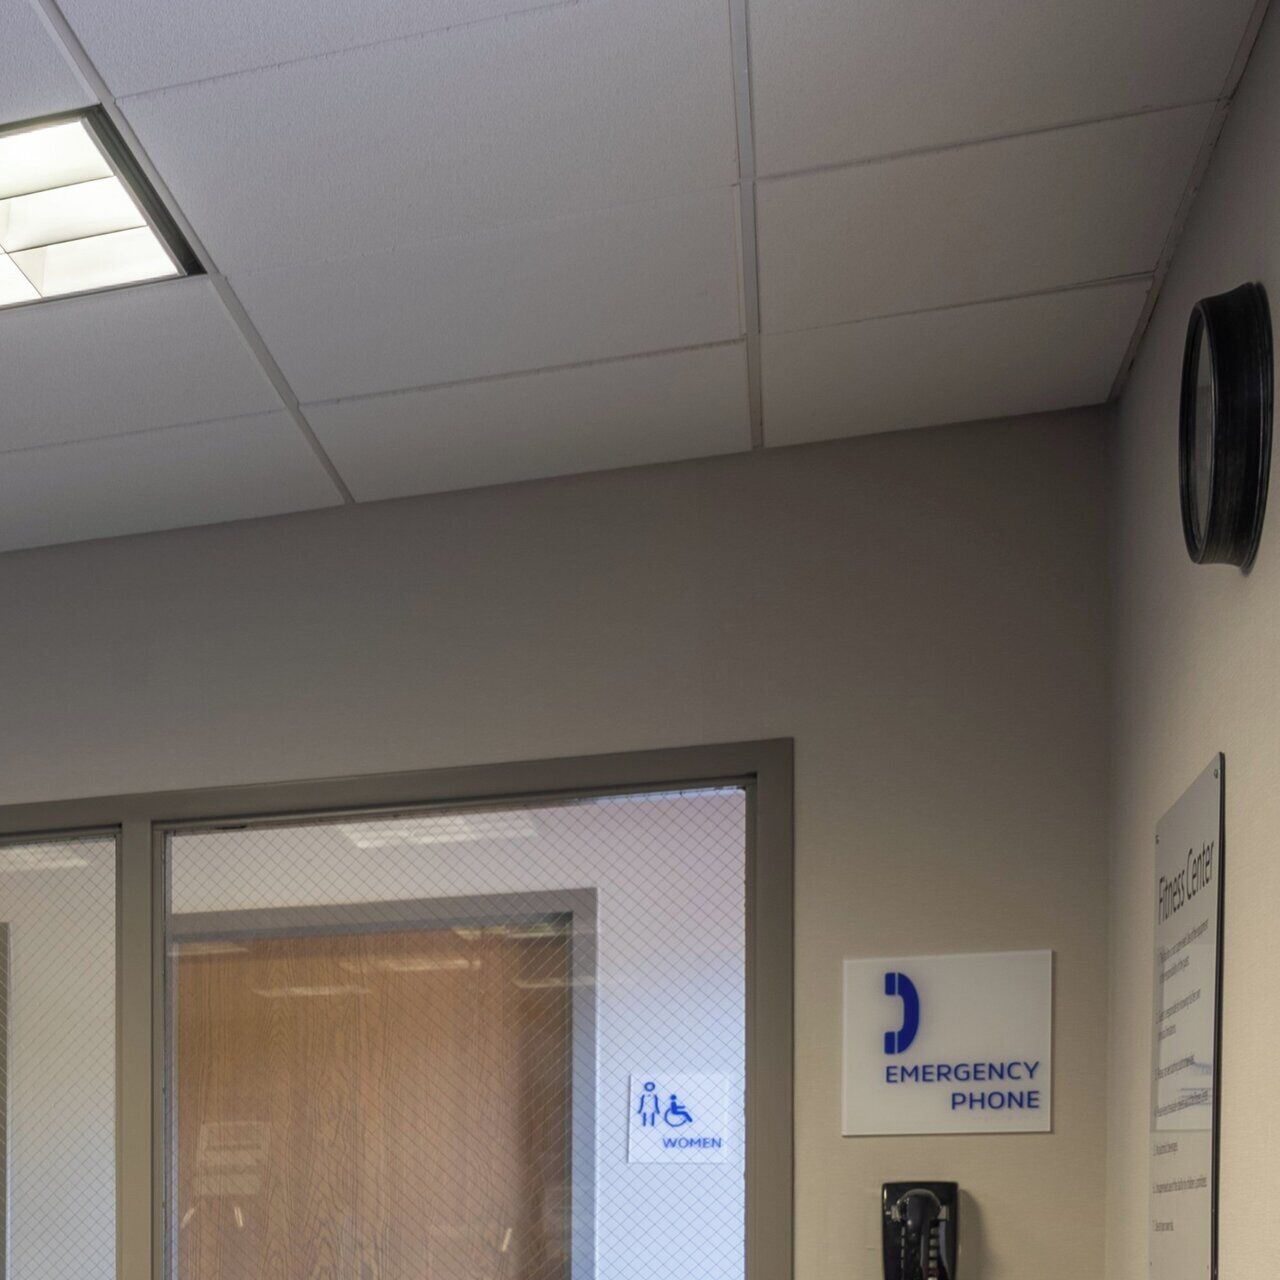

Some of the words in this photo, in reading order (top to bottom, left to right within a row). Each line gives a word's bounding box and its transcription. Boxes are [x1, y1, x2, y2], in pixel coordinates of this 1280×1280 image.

[1159, 869, 1185, 925] Fitness
[1186, 841, 1214, 900] Center
[885, 1061, 1040, 1083] EMERGENCY
[951, 1091, 1040, 1110] PHONE
[662, 1137, 722, 1149] WOMEN
